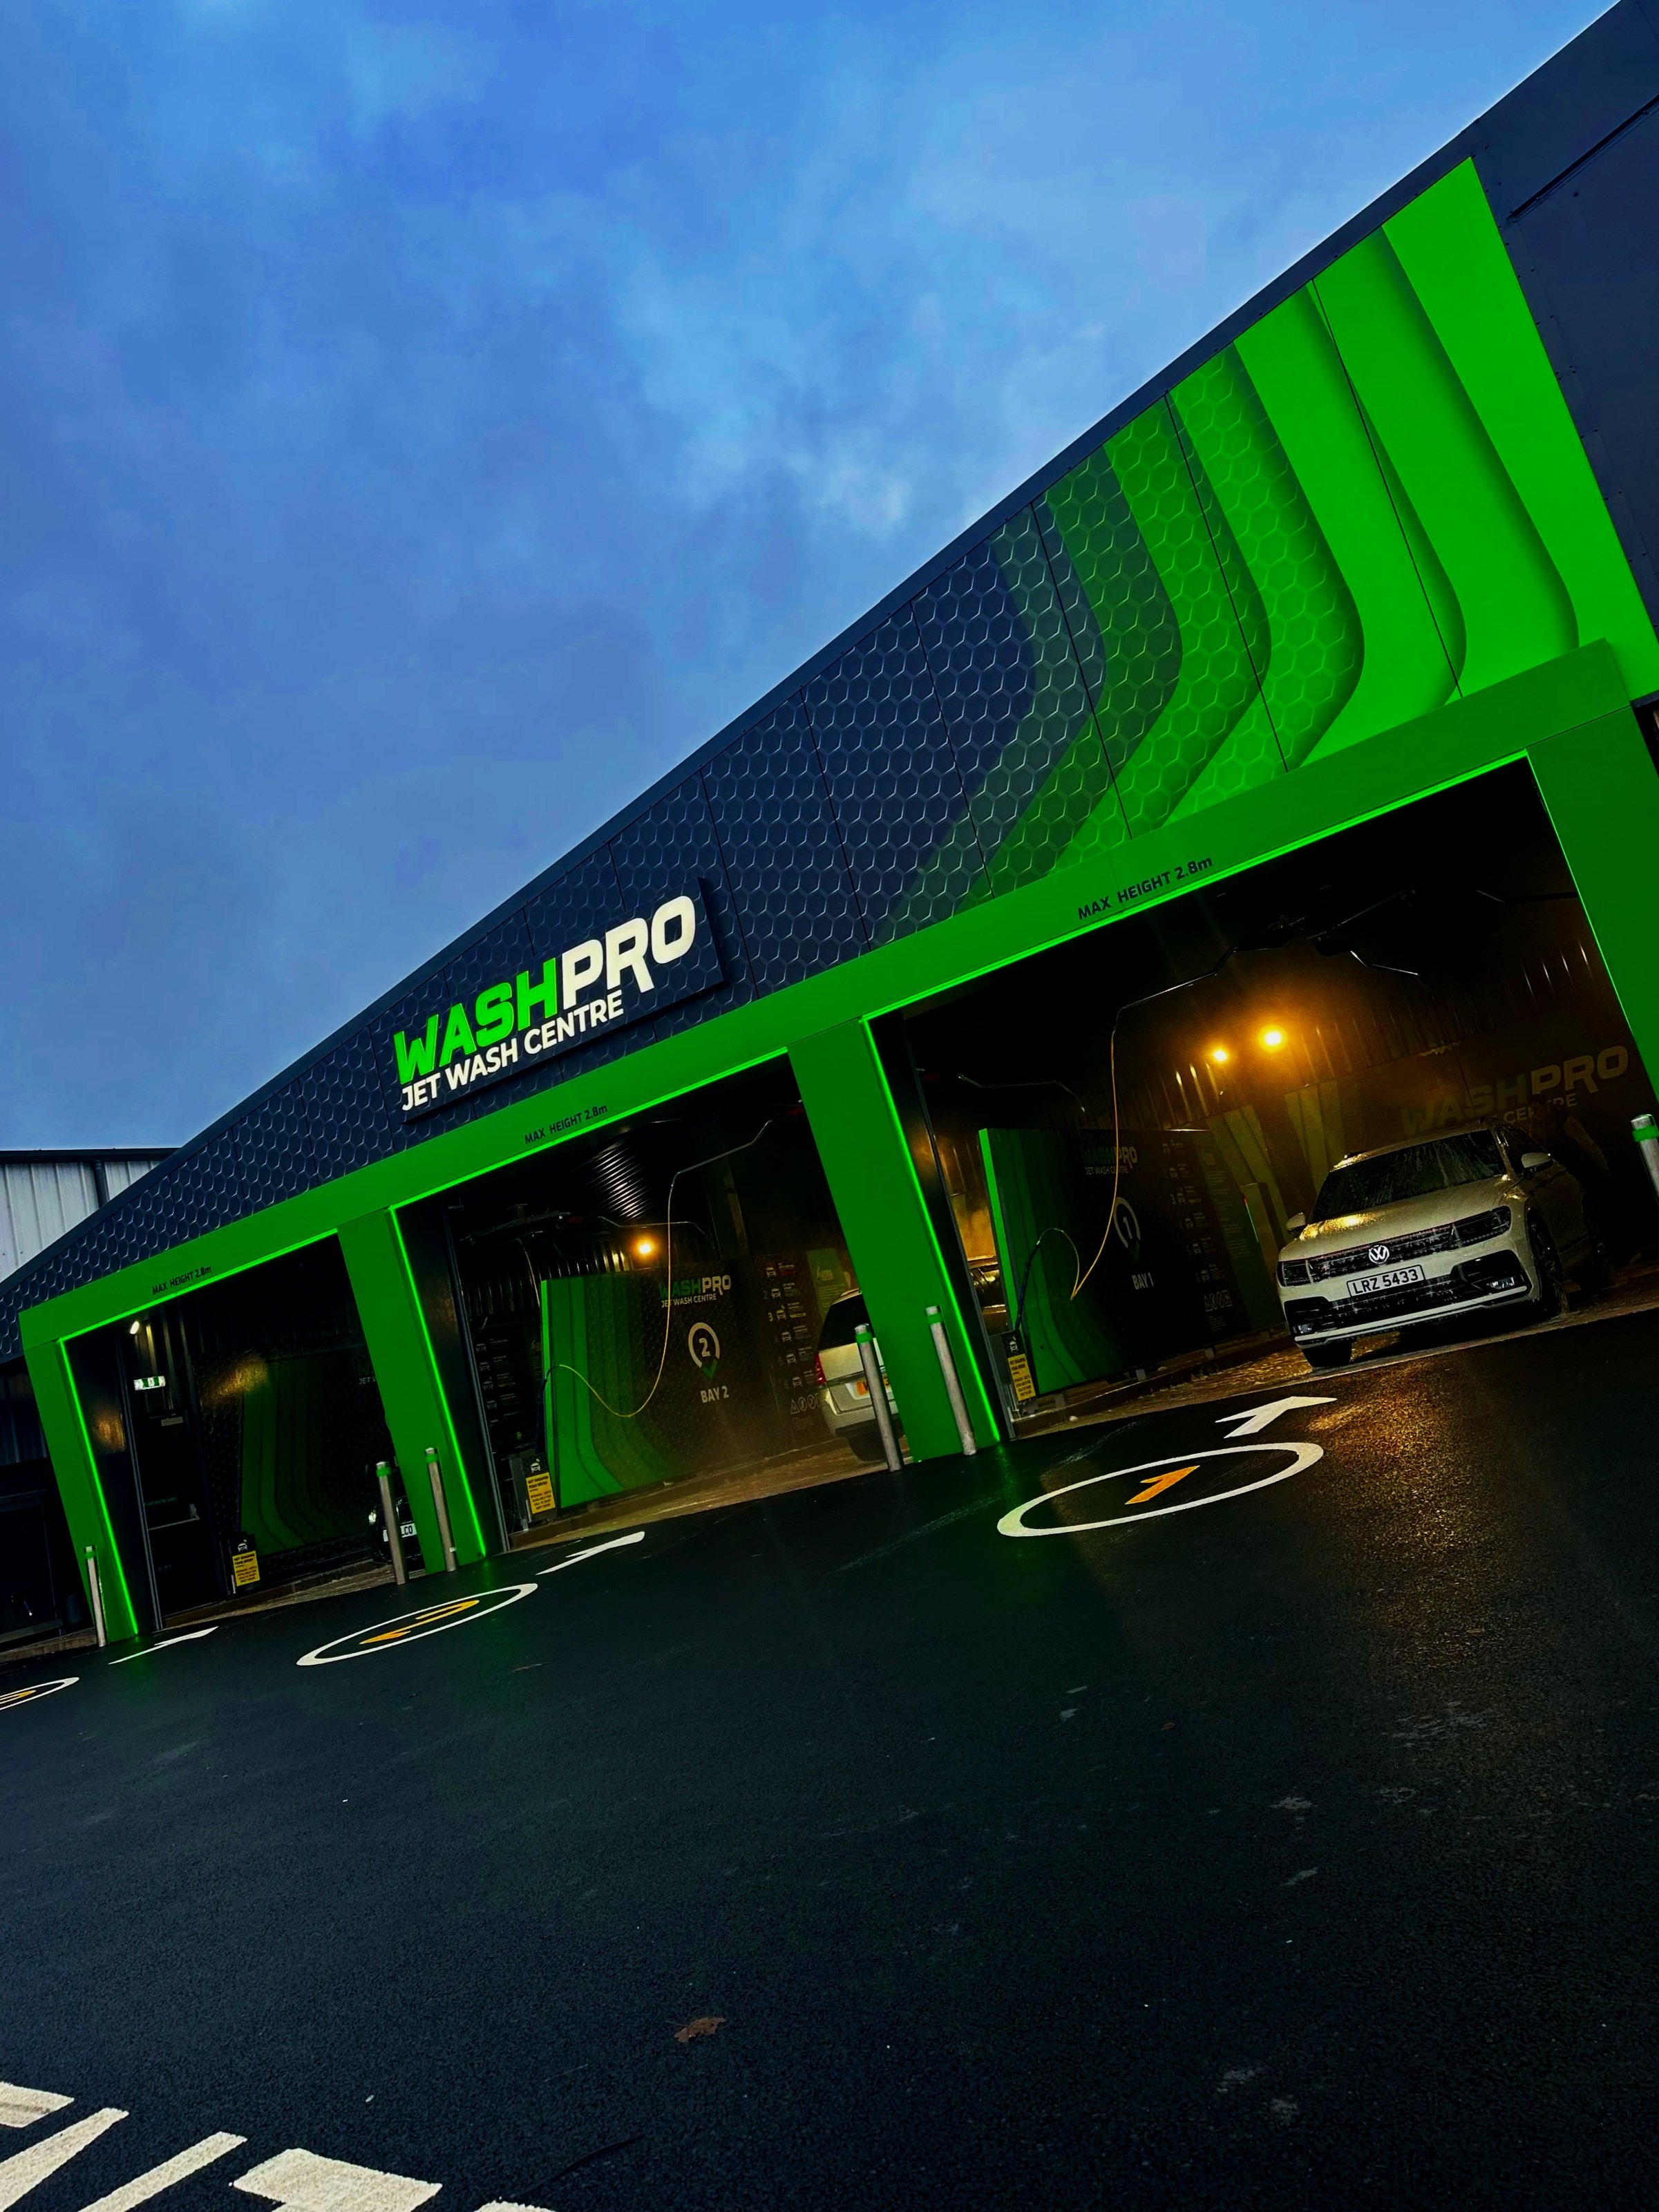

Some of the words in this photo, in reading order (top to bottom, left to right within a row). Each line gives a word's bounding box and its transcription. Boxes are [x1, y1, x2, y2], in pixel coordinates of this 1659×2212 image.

[1078, 896, 1111, 920] MAX
[1117, 871, 1170, 903] HEIGHT
[1174, 858, 1213, 880] 2.8m
[393, 896, 695, 1085] WASHPRO
[401, 1072, 440, 1111] JET
[446, 1039, 518, 1090] WASH
[524, 990, 624, 1055] CENTRE
[1399, 1045, 1629, 1136] WASHPRO
[1504, 1093, 1577, 1124] CERE
[525, 1128, 545, 1144] MAX
[549, 1113, 582, 1134] HEIGHT
[584, 1105, 607, 1120] 2.8m
[1123, 1216, 1133, 1240] 1
[152, 1281, 167, 1294] MAX
[169, 1271, 193, 1287] HEIGHT
[194, 1267, 211, 1278] 2.8m
[659, 1275, 731, 1299] WASHPRO
[1132, 1273, 1148, 1290] BAY
[1148, 1272, 1154, 1287] 1
[1353, 1277, 1380, 1294] LRZ
[1383, 1269, 1418, 1287] 5433
[673, 1296, 692, 1306] WASH
[693, 1294, 717, 1303] CENTRE
[699, 1338, 711, 1357] 2
[359, 1377, 370, 1385] JET
[700, 1387, 720, 1403] BAY
[721, 1386, 730, 1399] 2
